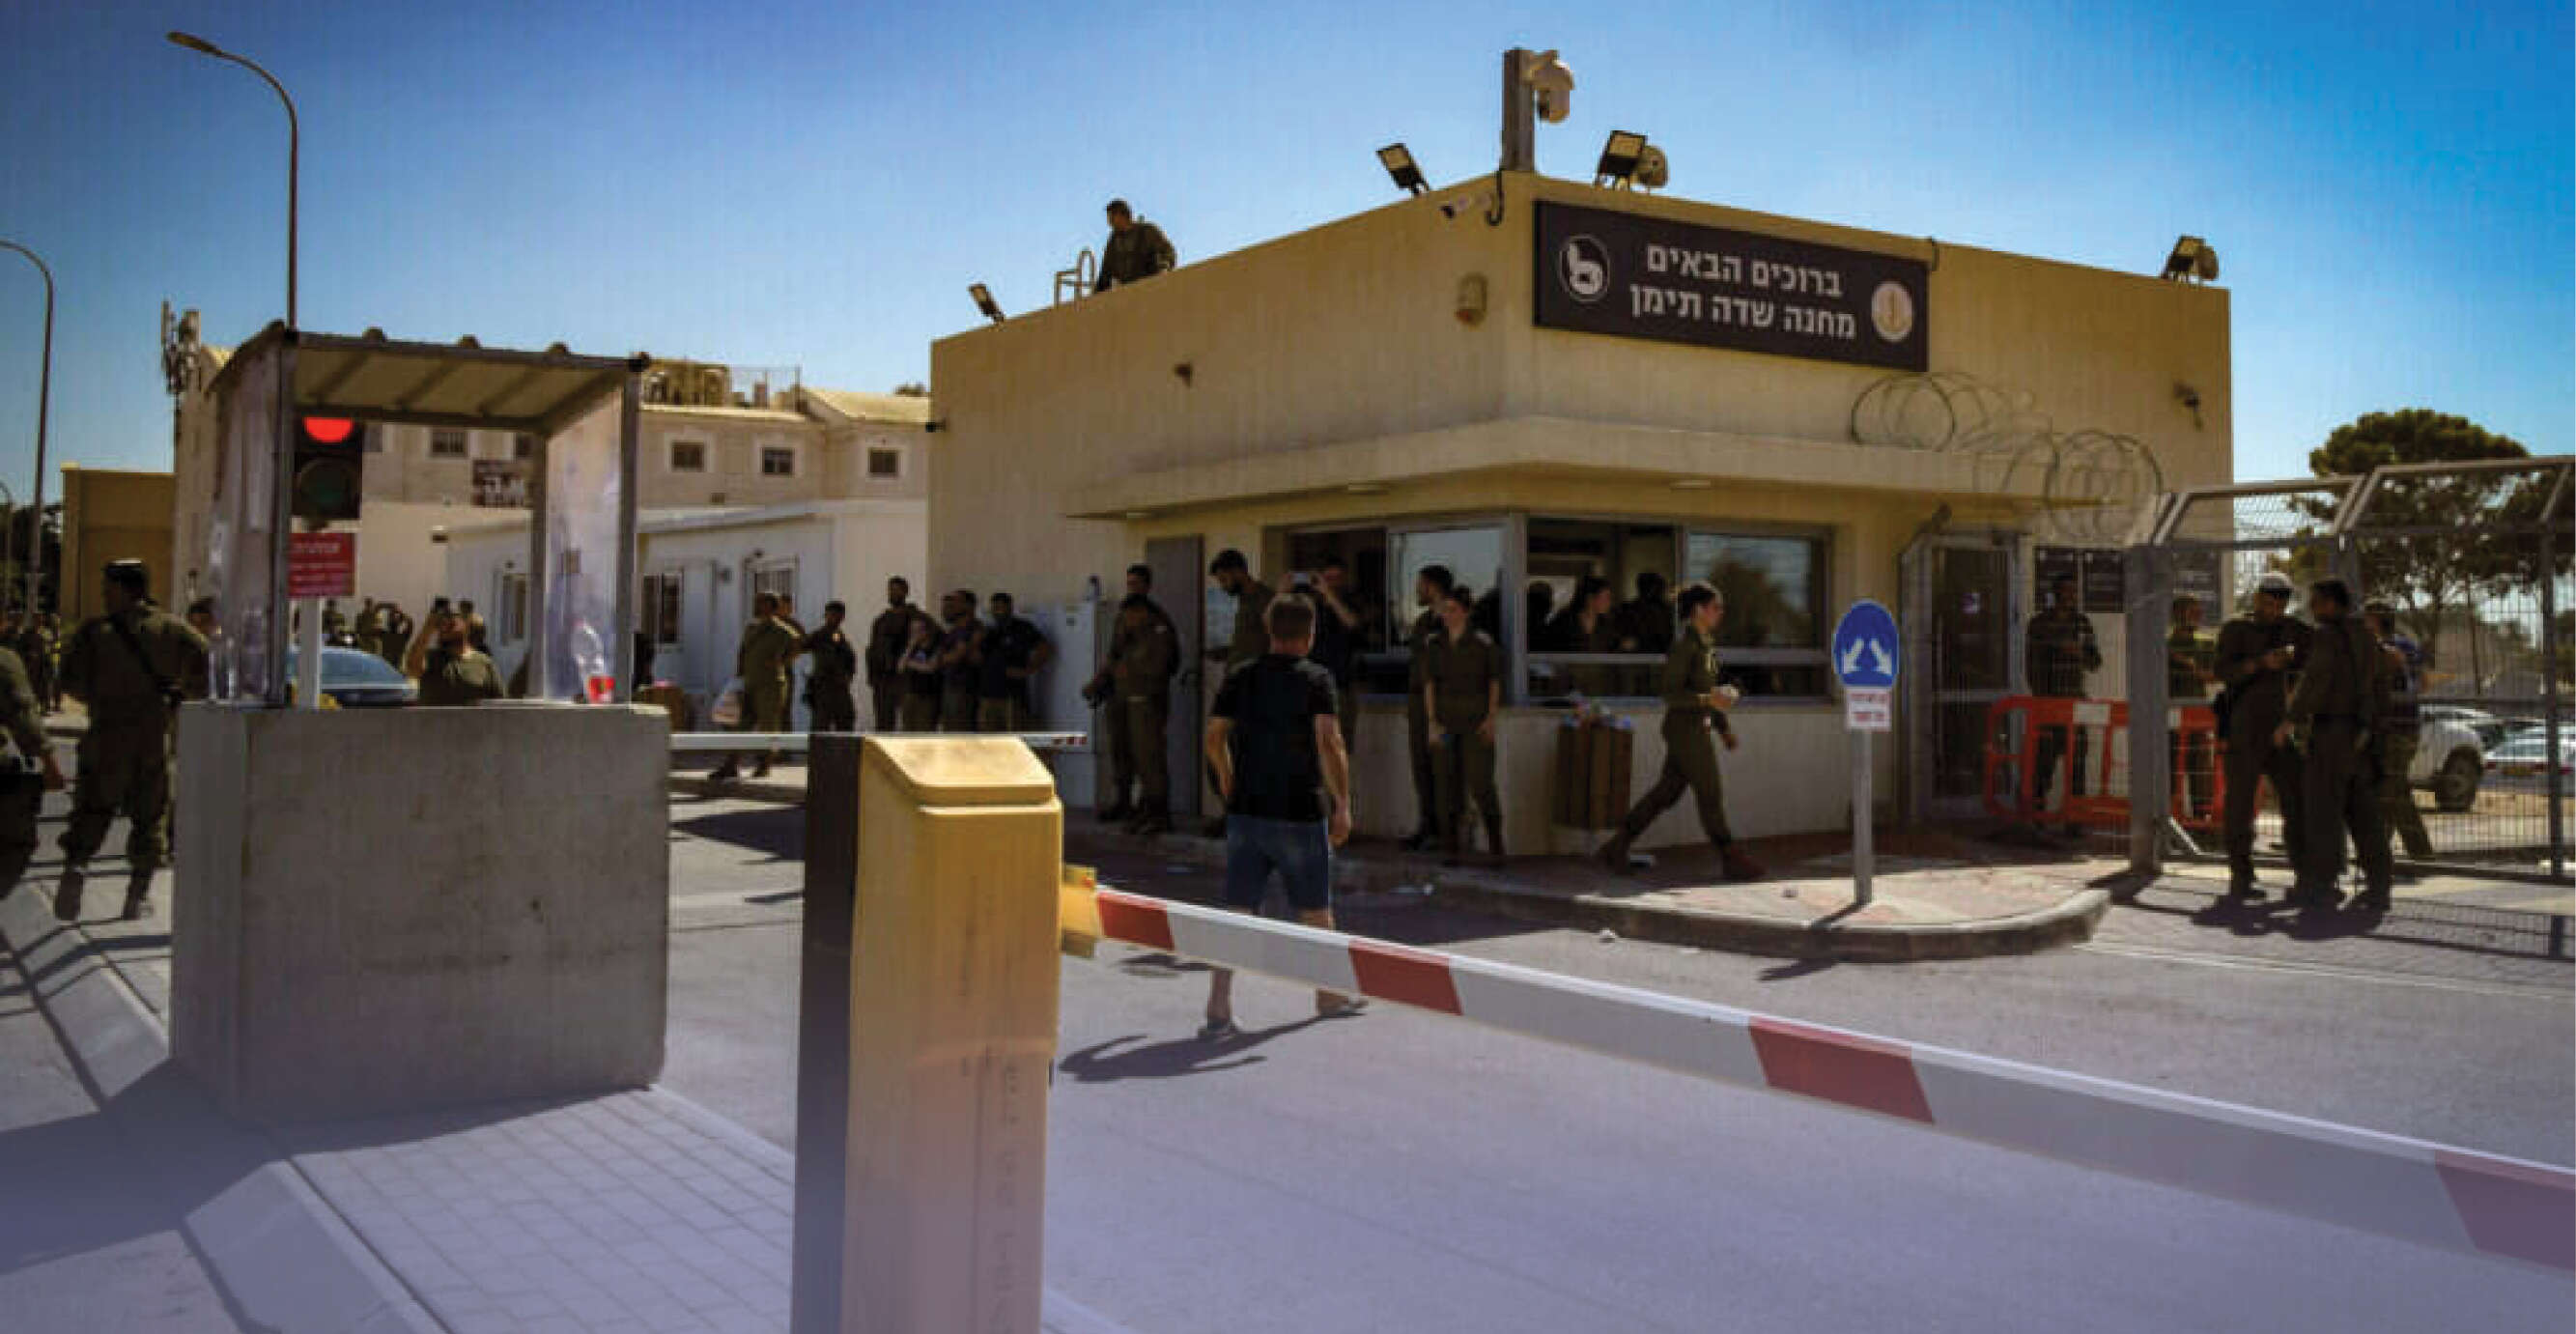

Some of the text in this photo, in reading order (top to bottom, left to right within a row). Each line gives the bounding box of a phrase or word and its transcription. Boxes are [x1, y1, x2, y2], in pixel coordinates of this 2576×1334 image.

[1647, 244, 1843, 297] ברוכים הבאים
[1629, 284, 1856, 339] מחנה שדה תימן
